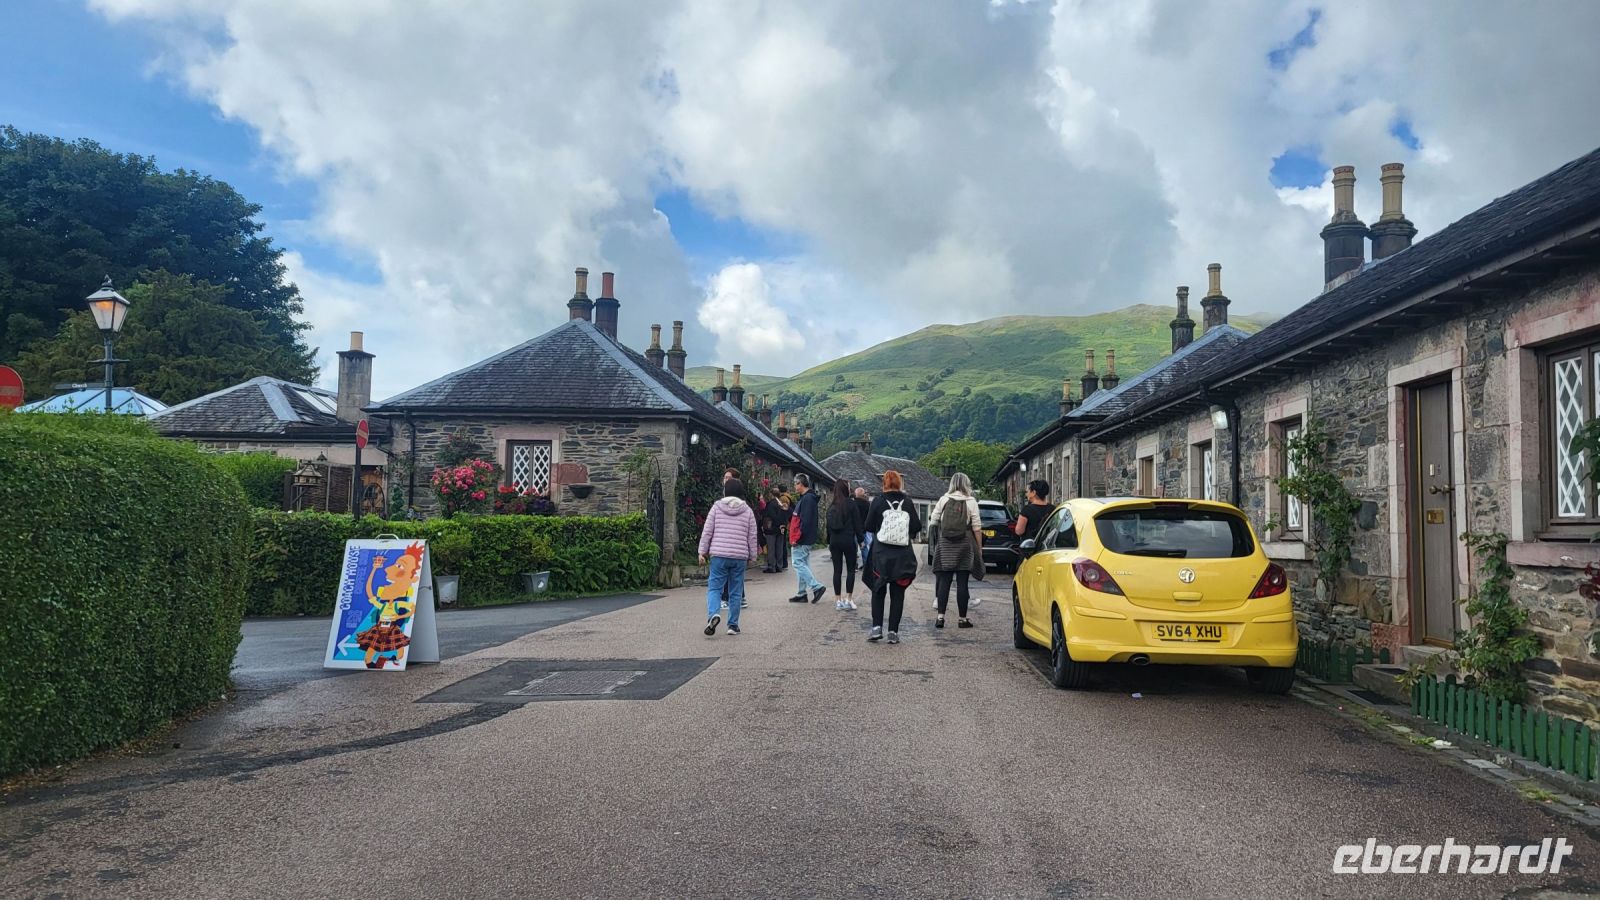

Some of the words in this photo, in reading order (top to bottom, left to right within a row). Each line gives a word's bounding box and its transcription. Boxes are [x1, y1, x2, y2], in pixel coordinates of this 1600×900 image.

[344, 545, 361, 576] HOUSE
[339, 577, 356, 611] COACH
[1156, 625, 1192, 637] SV64
[1195, 625, 1222, 638] XHU
